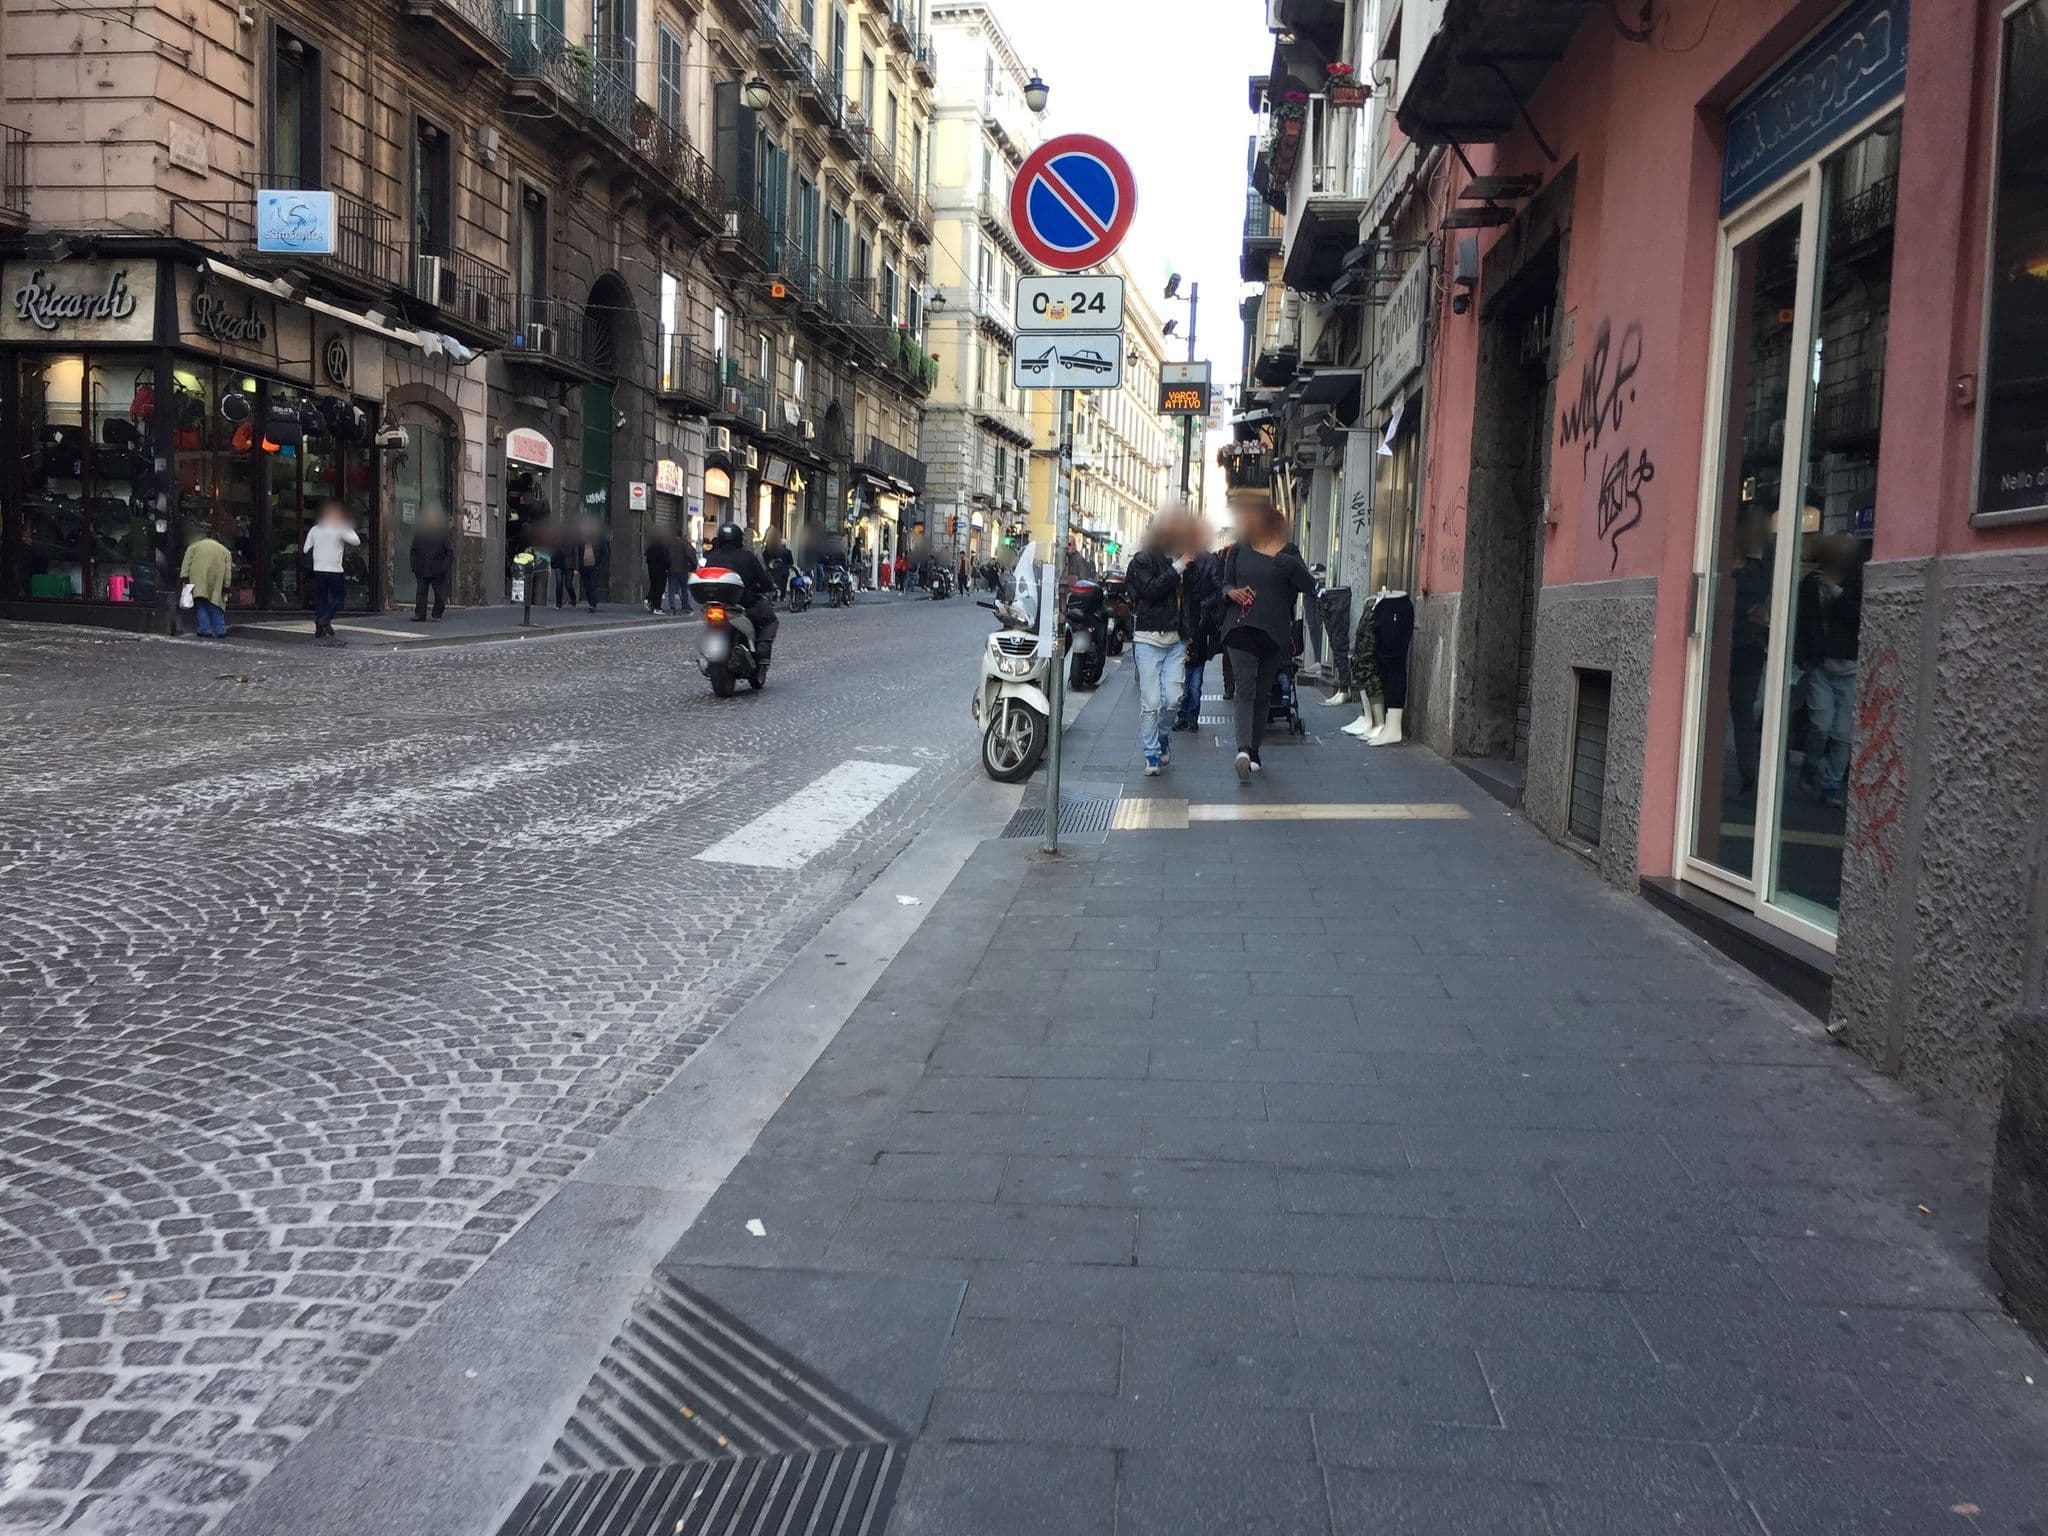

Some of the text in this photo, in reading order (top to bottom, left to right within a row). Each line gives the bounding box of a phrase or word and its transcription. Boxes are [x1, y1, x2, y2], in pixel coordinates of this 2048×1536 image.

[15, 269, 137, 330] Riccardi
[1071, 291, 1106, 314] 24
[1165, 400, 1201, 409] ATTIVO
[1168, 391, 1199, 402] VARCO
